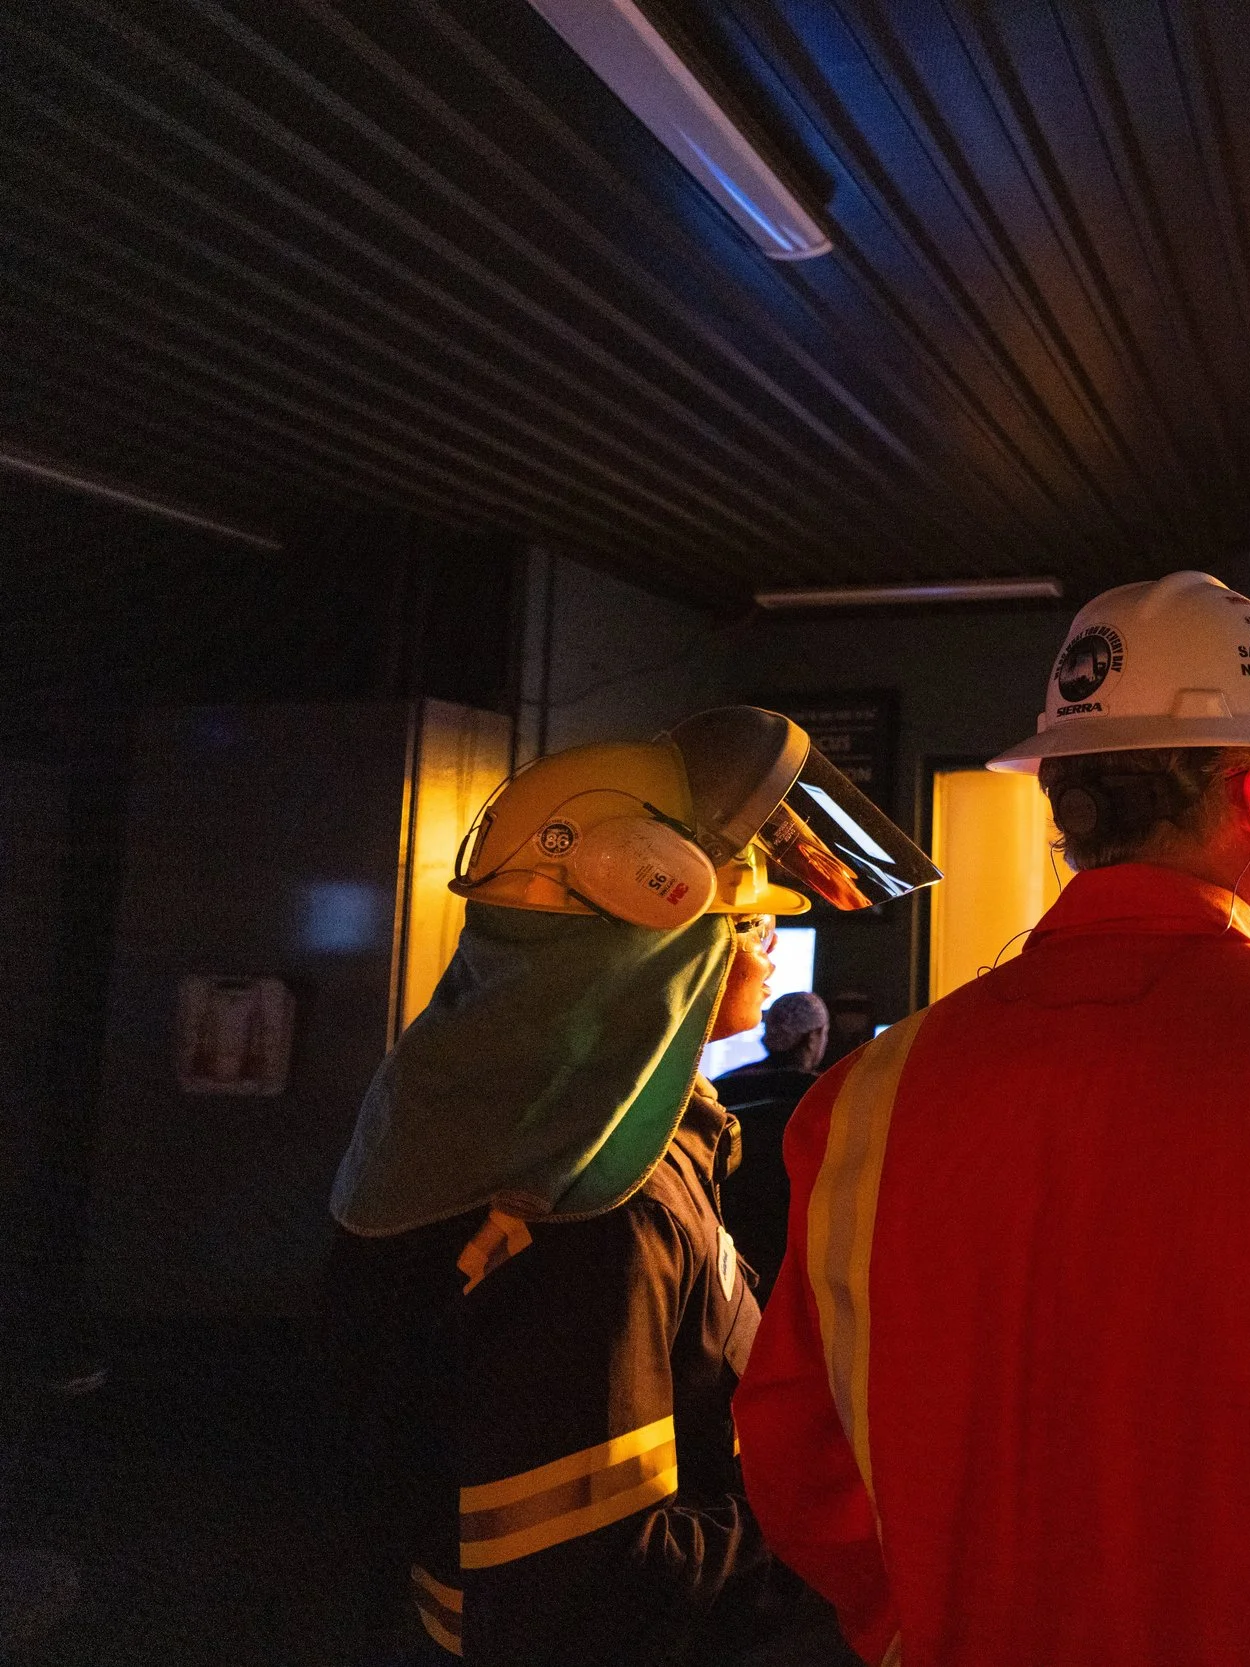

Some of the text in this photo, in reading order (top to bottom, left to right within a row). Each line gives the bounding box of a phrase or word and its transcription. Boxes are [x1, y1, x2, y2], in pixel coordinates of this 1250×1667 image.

[1056, 702, 1103, 718] SIERRA
[545, 833, 569, 849] 86
[649, 872, 667, 890] 95
